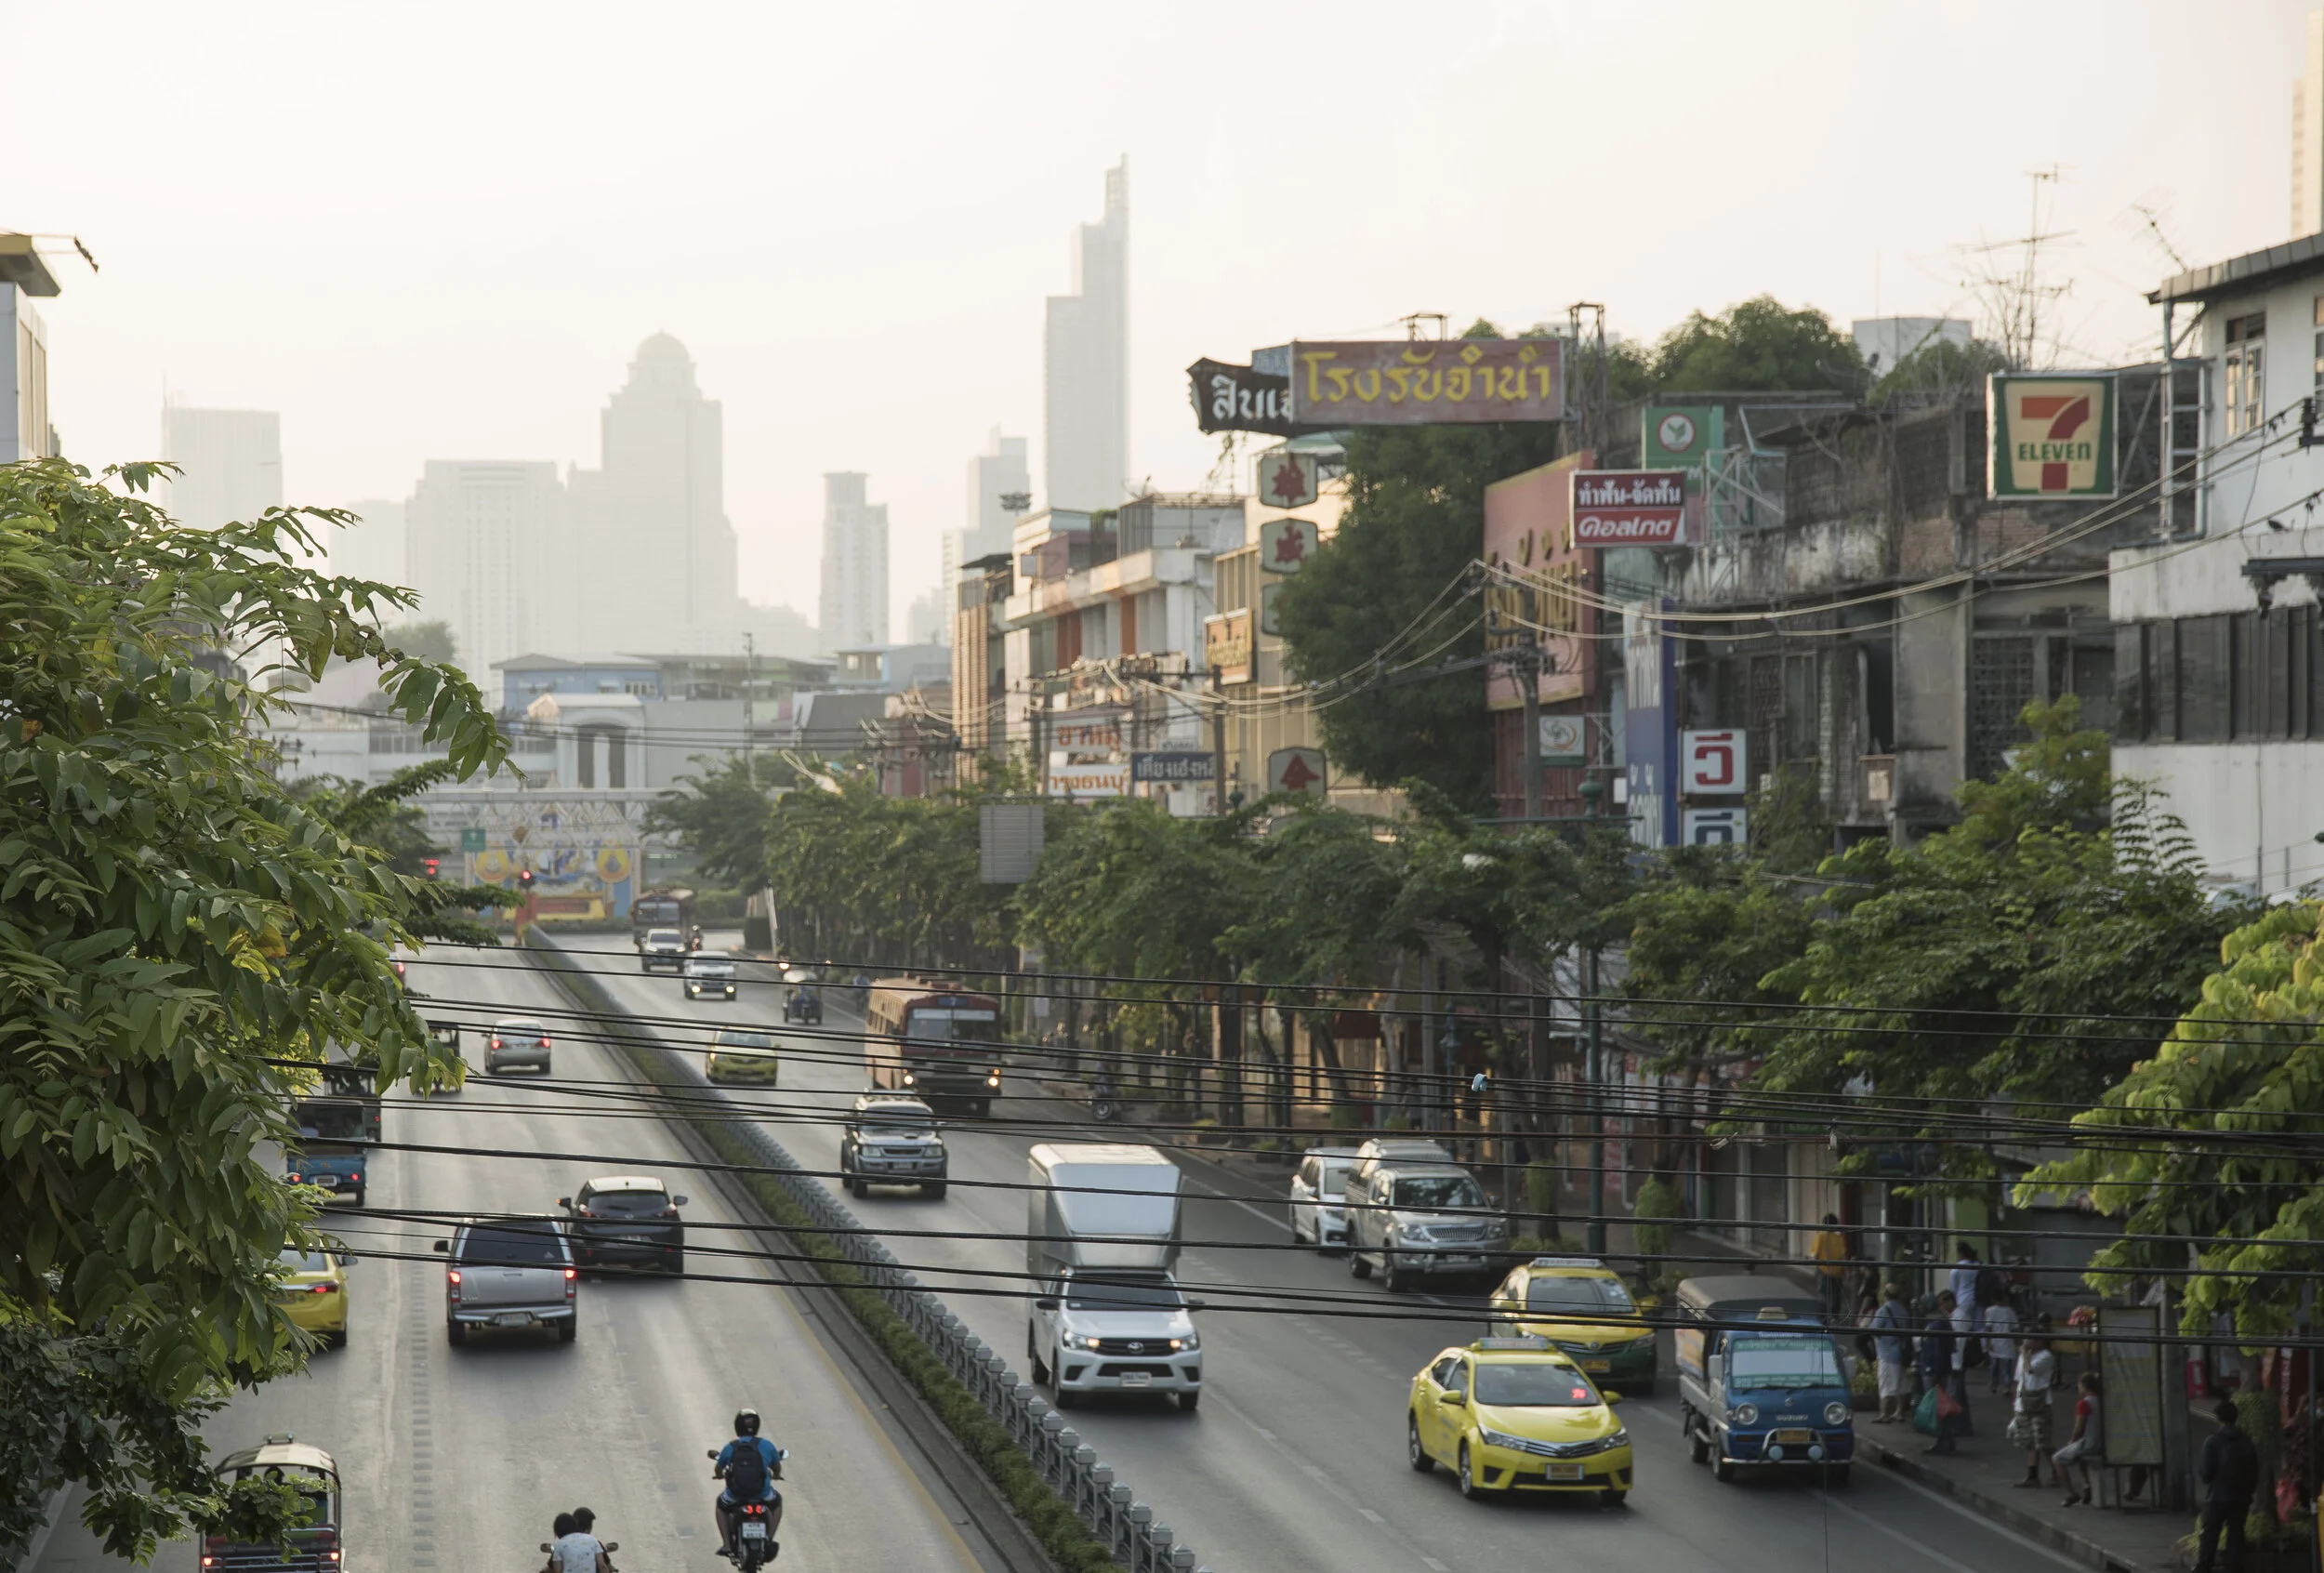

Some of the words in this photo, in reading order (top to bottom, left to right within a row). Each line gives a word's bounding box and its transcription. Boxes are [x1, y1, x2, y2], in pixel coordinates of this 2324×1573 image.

[1302, 342, 1551, 403] โรงรับจำนำ
[1578, 477, 1682, 506] ทำฟัน-จัดฟัน
[1578, 514, 1674, 537] คอลเกต
